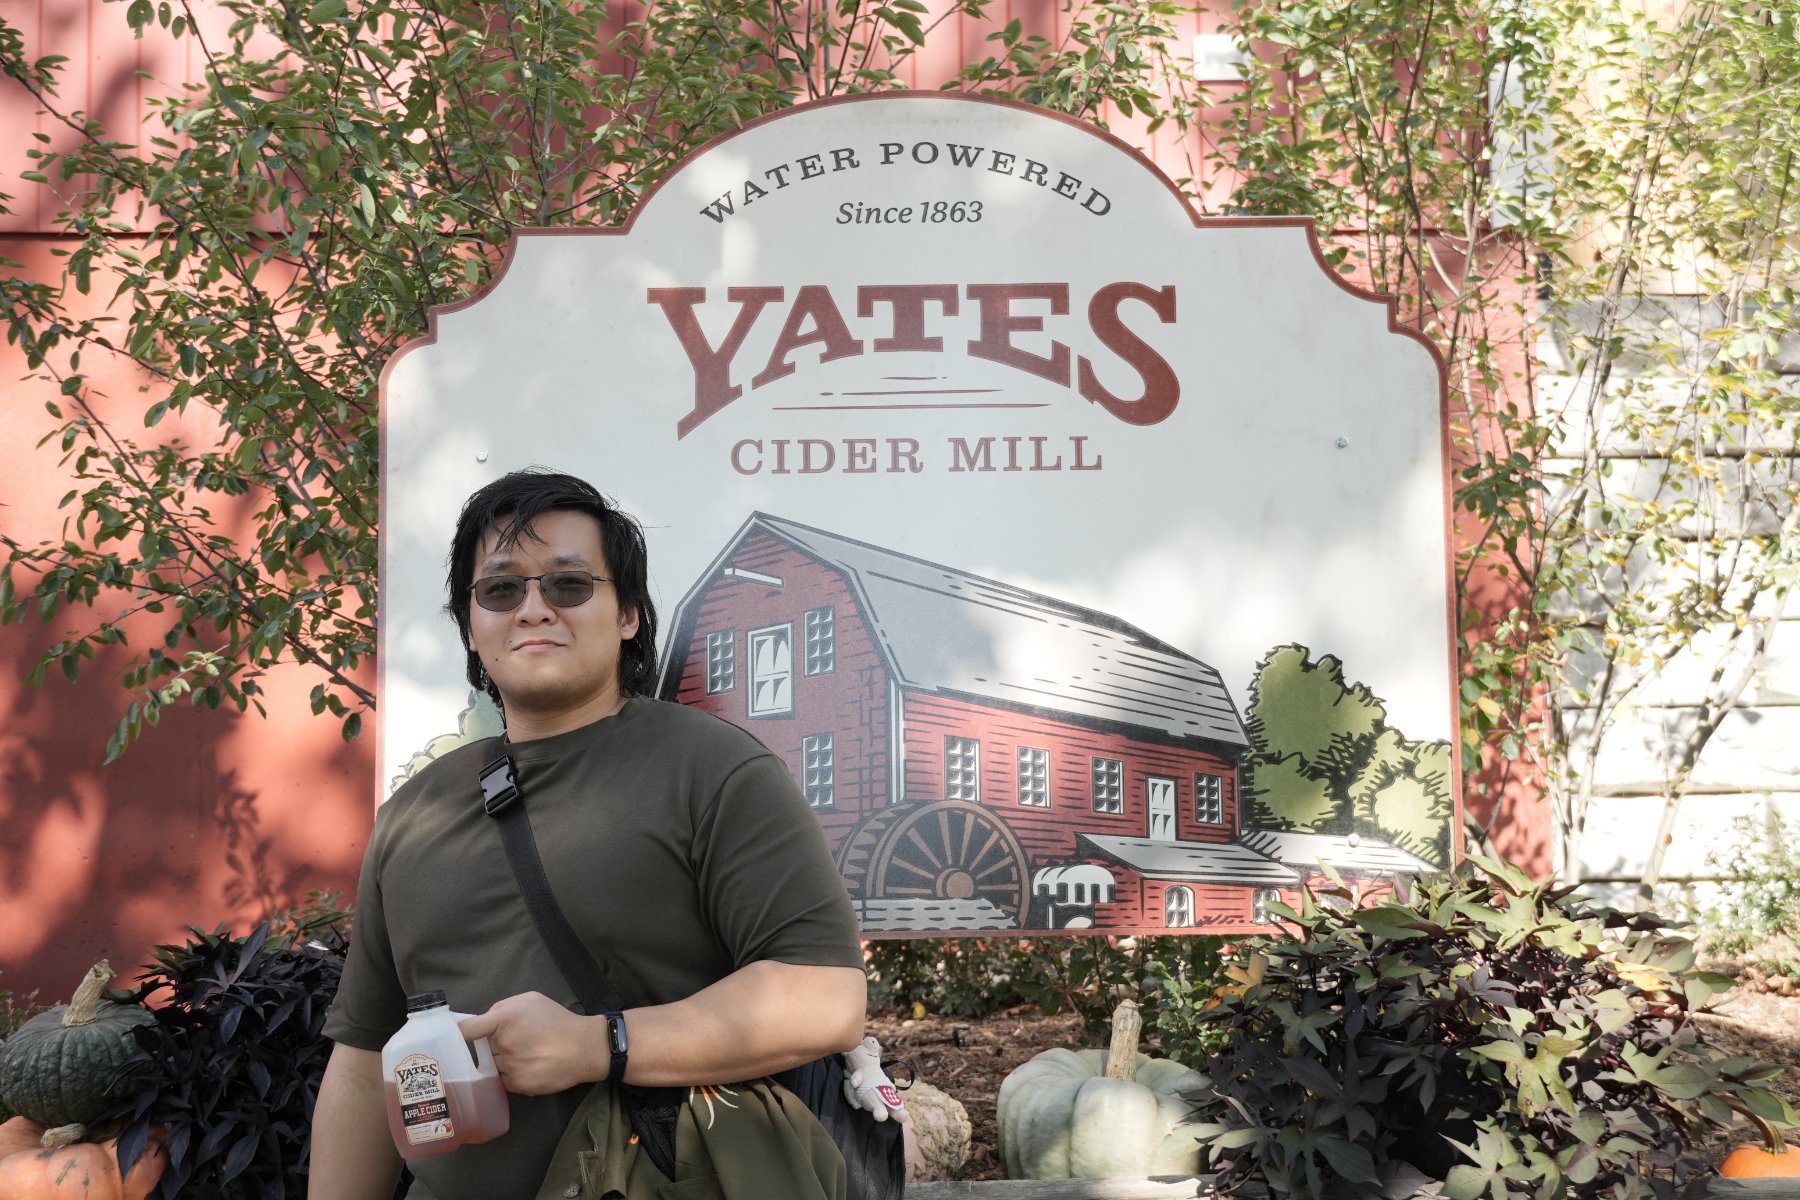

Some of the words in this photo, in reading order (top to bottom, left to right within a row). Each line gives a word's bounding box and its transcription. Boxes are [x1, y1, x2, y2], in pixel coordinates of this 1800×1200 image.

[699, 147, 861, 225] WATER
[879, 141, 1112, 218] POWERED
[836, 202, 912, 225] Since
[920, 200, 984, 224] 1863
[646, 281, 1181, 441] YATES
[730, 437, 924, 476] CIDER
[947, 435, 1103, 473] MILL
[397, 1063, 438, 1084] YATES
[403, 1091, 423, 1099] CIDER
[404, 1107, 425, 1119] APPLE
[426, 1103, 447, 1115] CIDER
